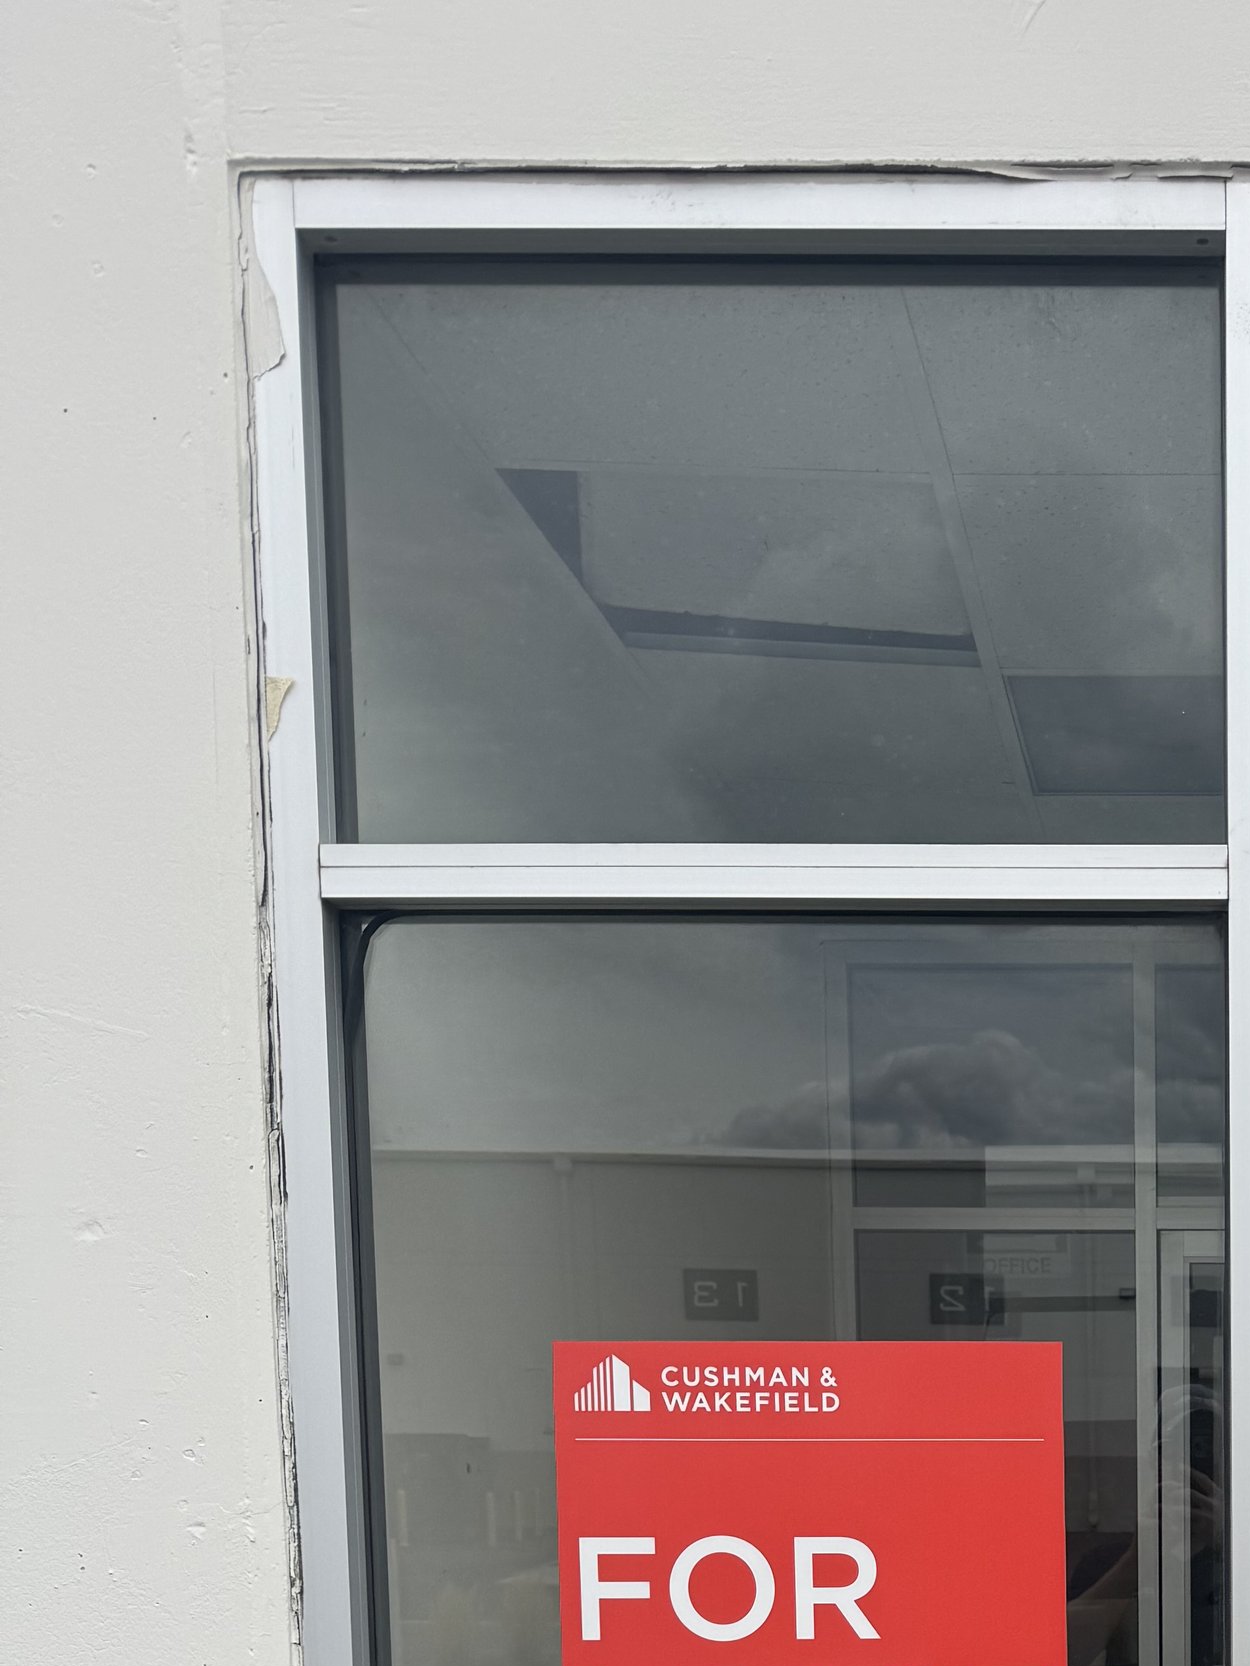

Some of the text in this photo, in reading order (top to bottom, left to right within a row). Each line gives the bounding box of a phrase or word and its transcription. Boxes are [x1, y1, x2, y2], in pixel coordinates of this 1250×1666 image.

[661, 1366, 838, 1387] CUSHMAN &
[661, 1391, 840, 1412] WAKEFIELD
[578, 1535, 881, 1642] FOR
